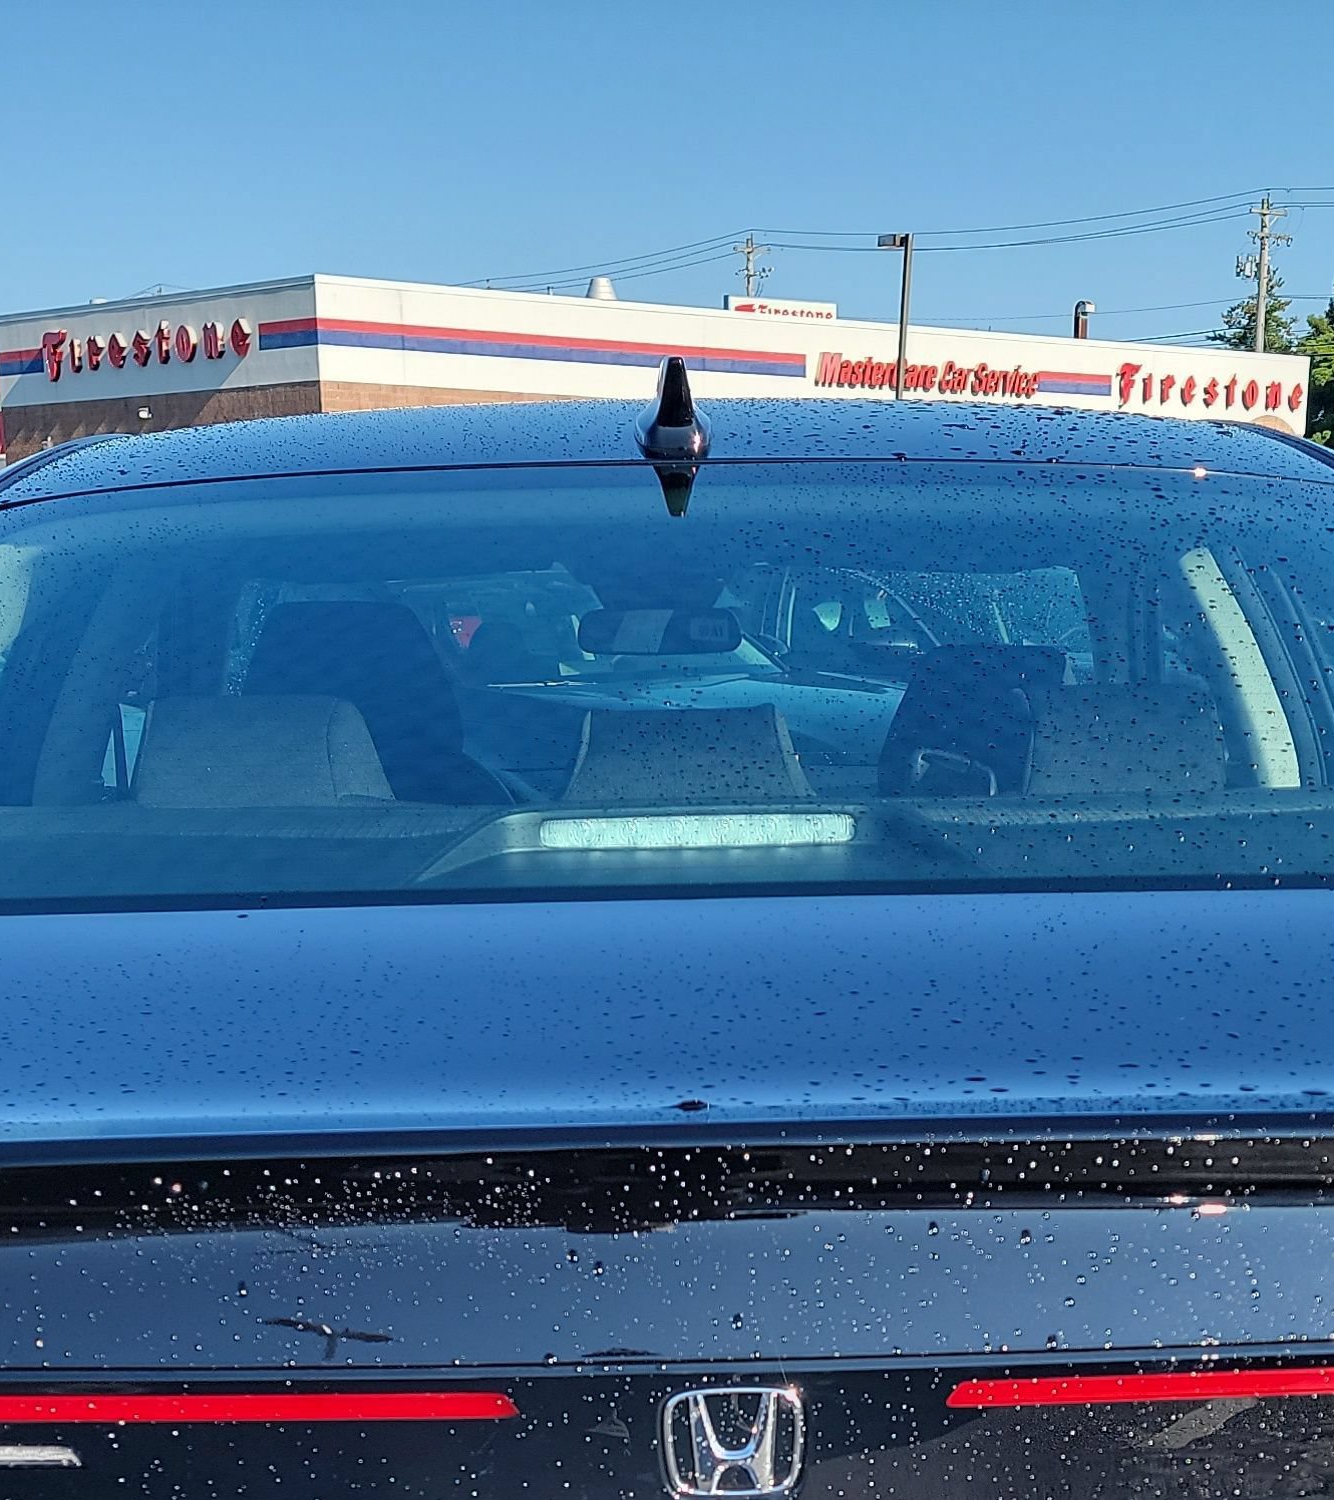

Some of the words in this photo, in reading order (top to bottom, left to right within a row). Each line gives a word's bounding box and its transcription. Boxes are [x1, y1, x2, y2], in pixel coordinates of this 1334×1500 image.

[42, 318, 252, 382] Firestone
[938, 360, 973, 394] Car
[971, 362, 1040, 399] Service
[1116, 362, 1304, 412] Firestone
